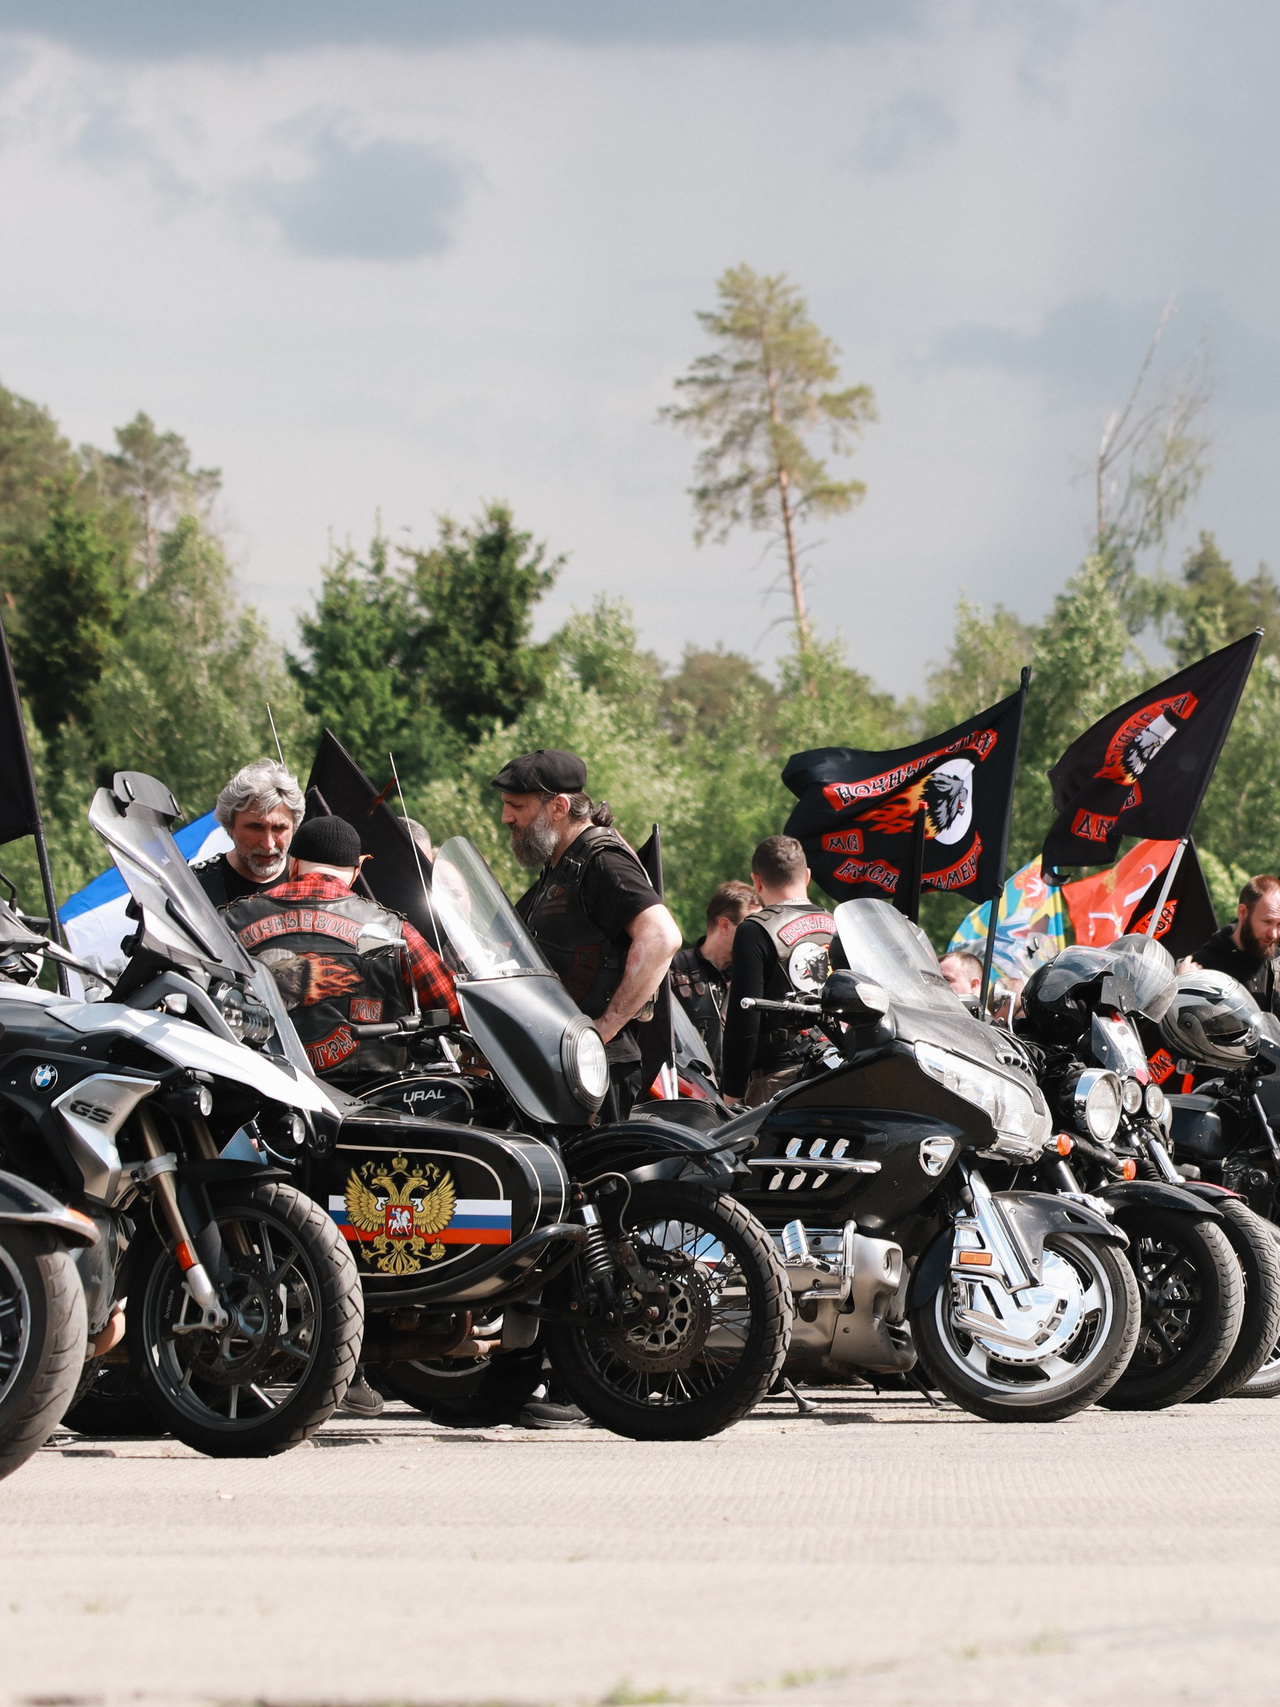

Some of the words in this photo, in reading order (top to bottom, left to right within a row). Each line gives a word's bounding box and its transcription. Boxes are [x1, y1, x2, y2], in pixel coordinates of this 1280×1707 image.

[828, 833, 859, 851] MC
[240, 912, 313, 948] НОЧНЫЕ
[315, 914, 360, 940] ВОЛК
[780, 916, 825, 944] НОЧНЫЕ
[352, 1001, 381, 1020] MC
[403, 1088, 446, 1103] URAL
[69, 1099, 115, 1124] GS
